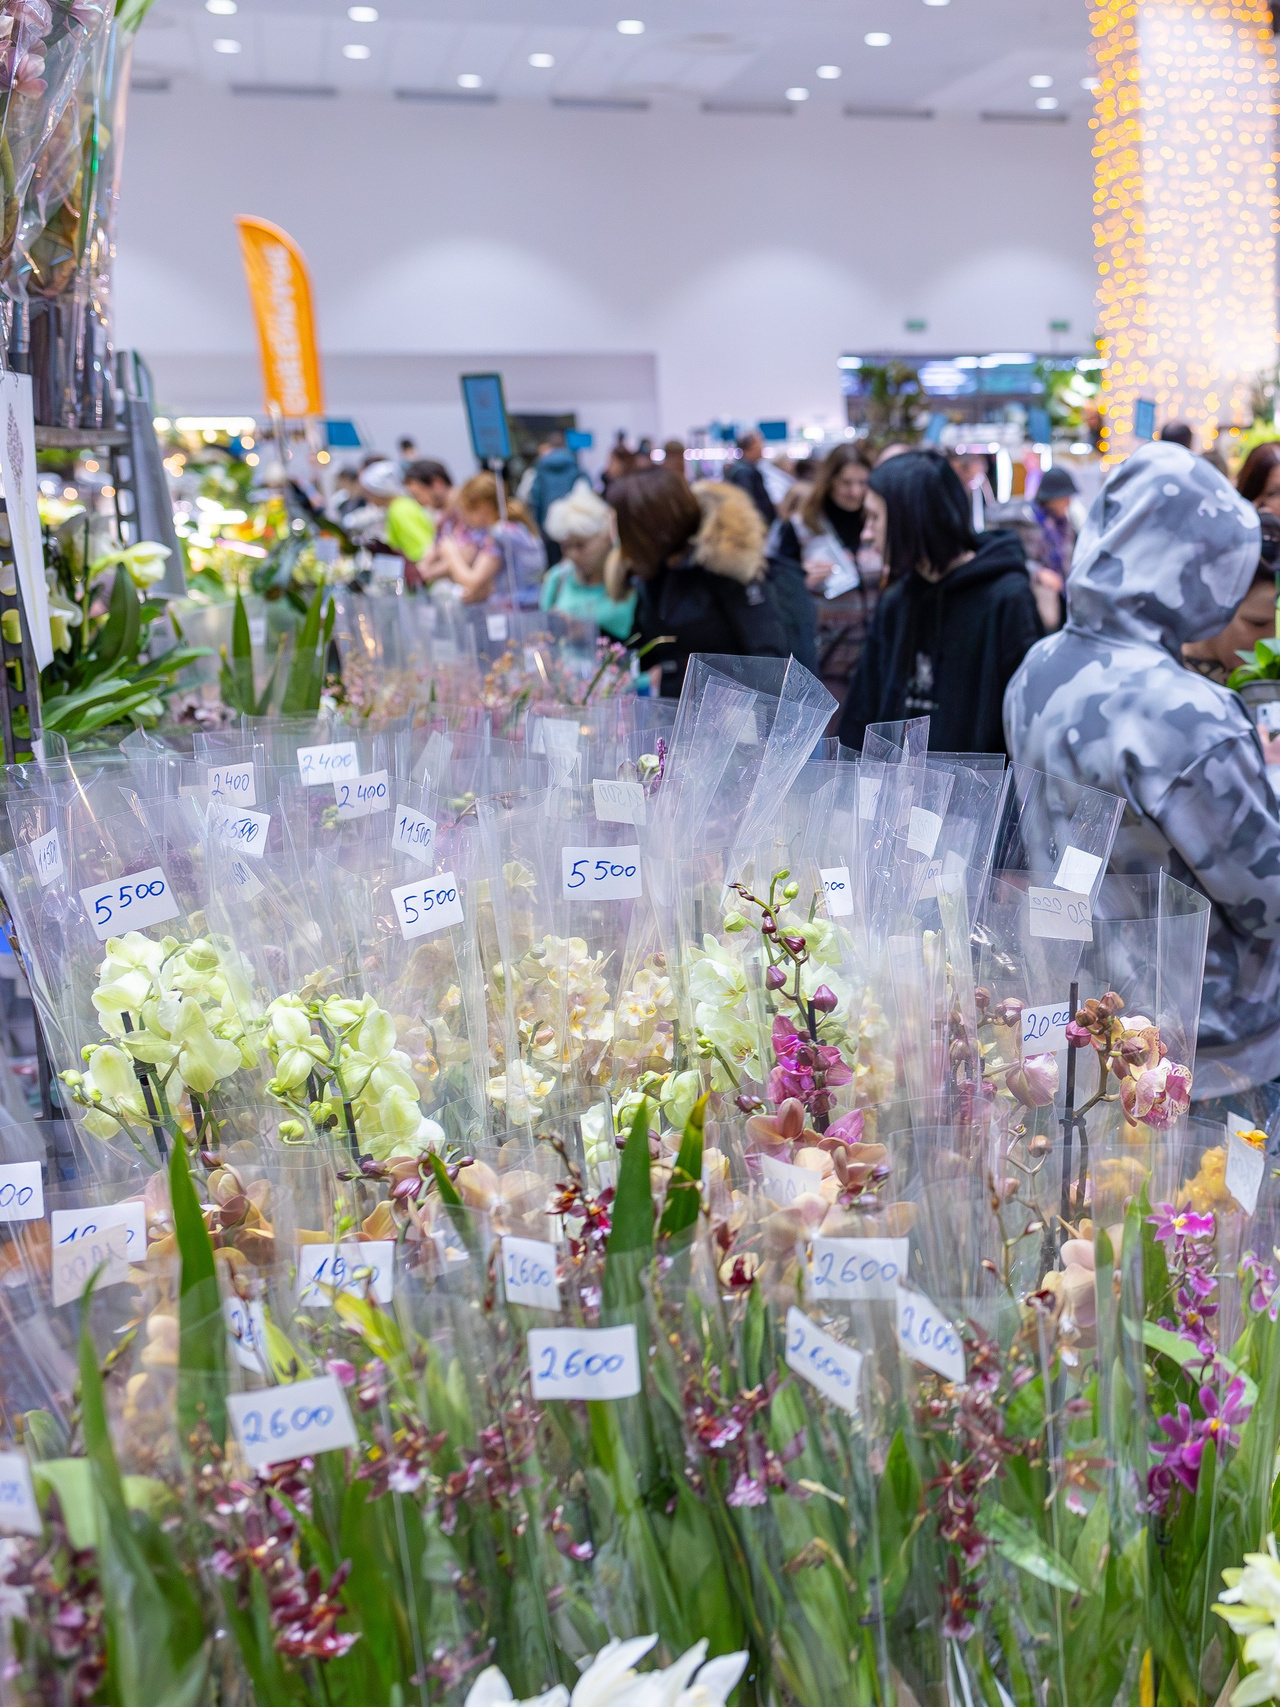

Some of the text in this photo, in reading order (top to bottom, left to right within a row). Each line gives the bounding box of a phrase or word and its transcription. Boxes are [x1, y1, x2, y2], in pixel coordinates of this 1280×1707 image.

[302, 752, 352, 773] 2400
[211, 771, 250, 796] 2400
[338, 782, 387, 808] 2400
[567, 859, 637, 888] 5500
[95, 880, 165, 925] 5500
[403, 888, 457, 924] 5500
[814, 1252, 898, 1288] 2600
[538, 1345, 625, 1381] 2600
[242, 1404, 335, 1446] 2600
